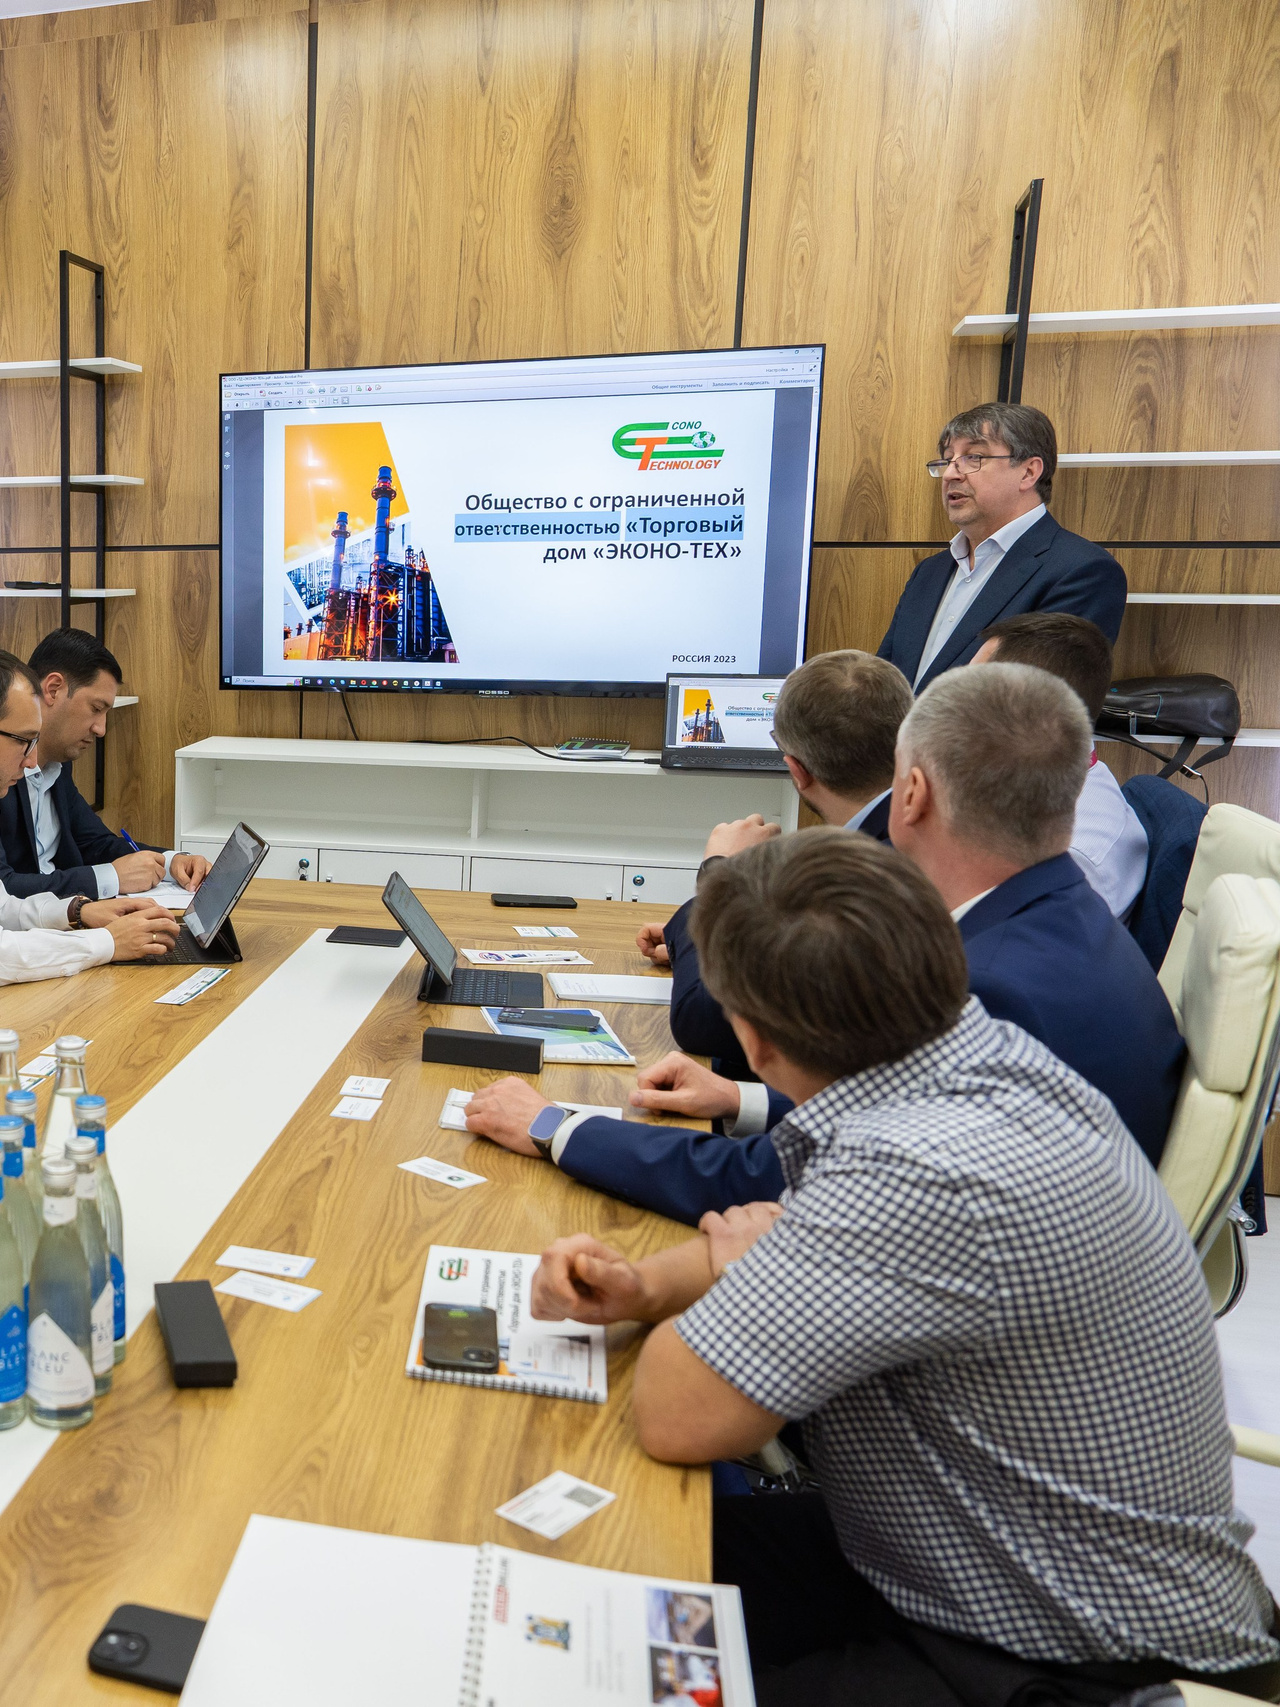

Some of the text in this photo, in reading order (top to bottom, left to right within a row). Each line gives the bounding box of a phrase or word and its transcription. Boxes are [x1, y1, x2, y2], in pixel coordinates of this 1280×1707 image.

[465, 488, 745, 513] Общество с ограниченной
[454, 515, 744, 537] ответственностью «Торговый
[543, 542, 742, 563] дом «ЭКОНО-ТЕХ»
[672, 655, 737, 663] РОССИЯ 2023
